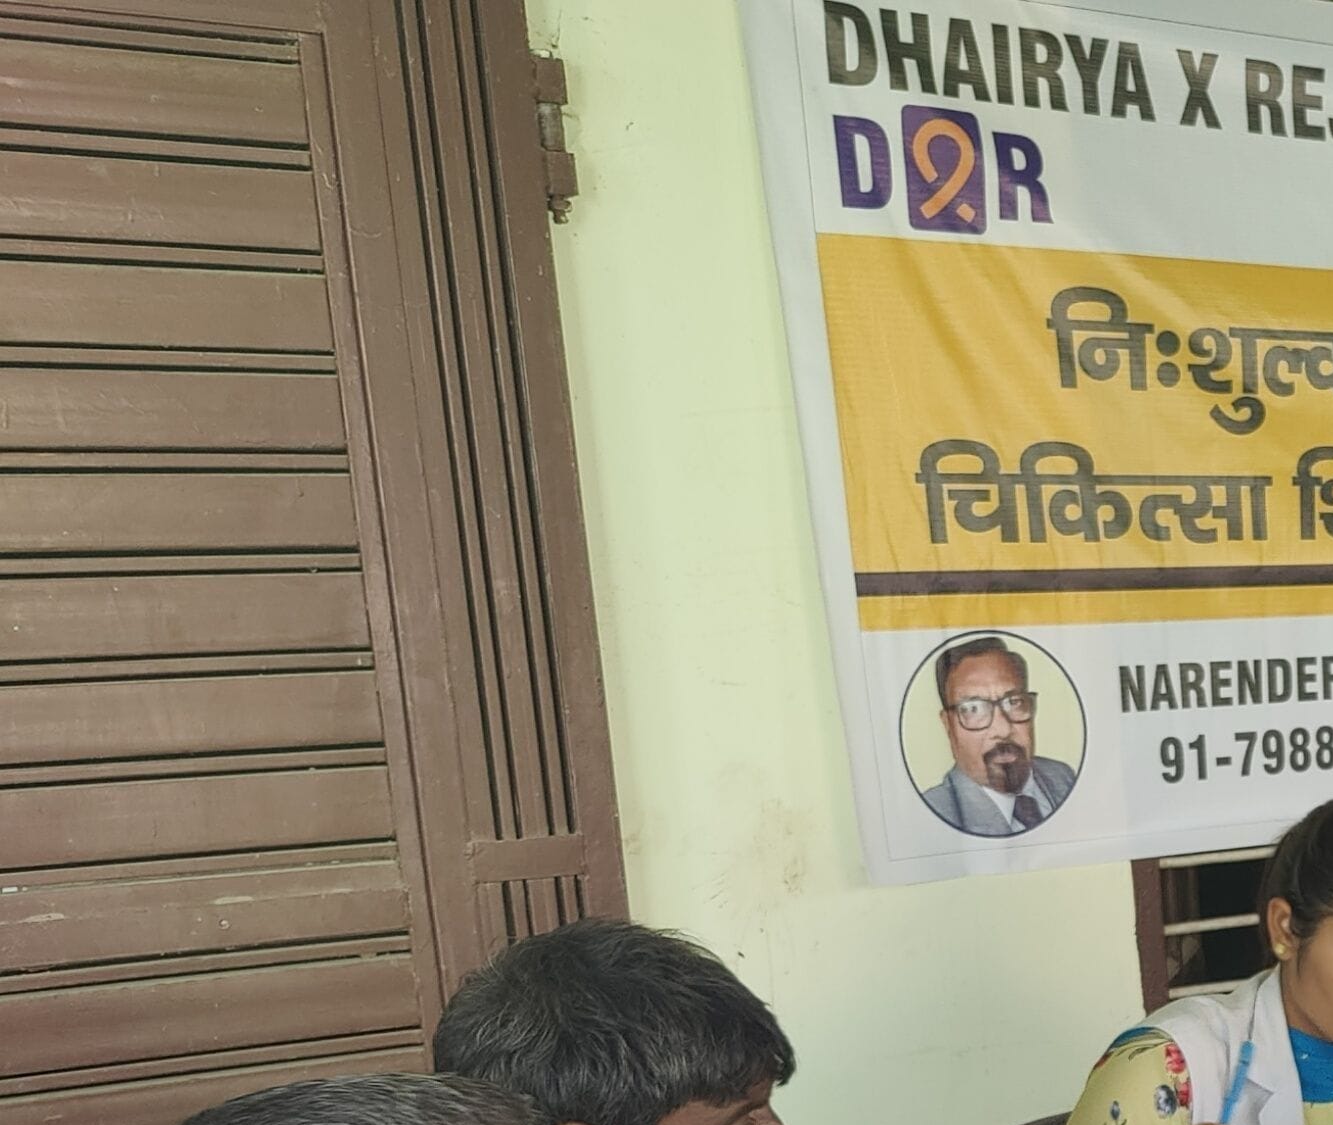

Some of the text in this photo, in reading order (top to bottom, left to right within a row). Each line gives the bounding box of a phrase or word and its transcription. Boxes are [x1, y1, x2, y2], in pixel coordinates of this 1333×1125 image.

[823, 0, 1156, 123] DHAIRYA
[1175, 48, 1222, 130] X
[915, 439, 1272, 545] चिकित्सा
